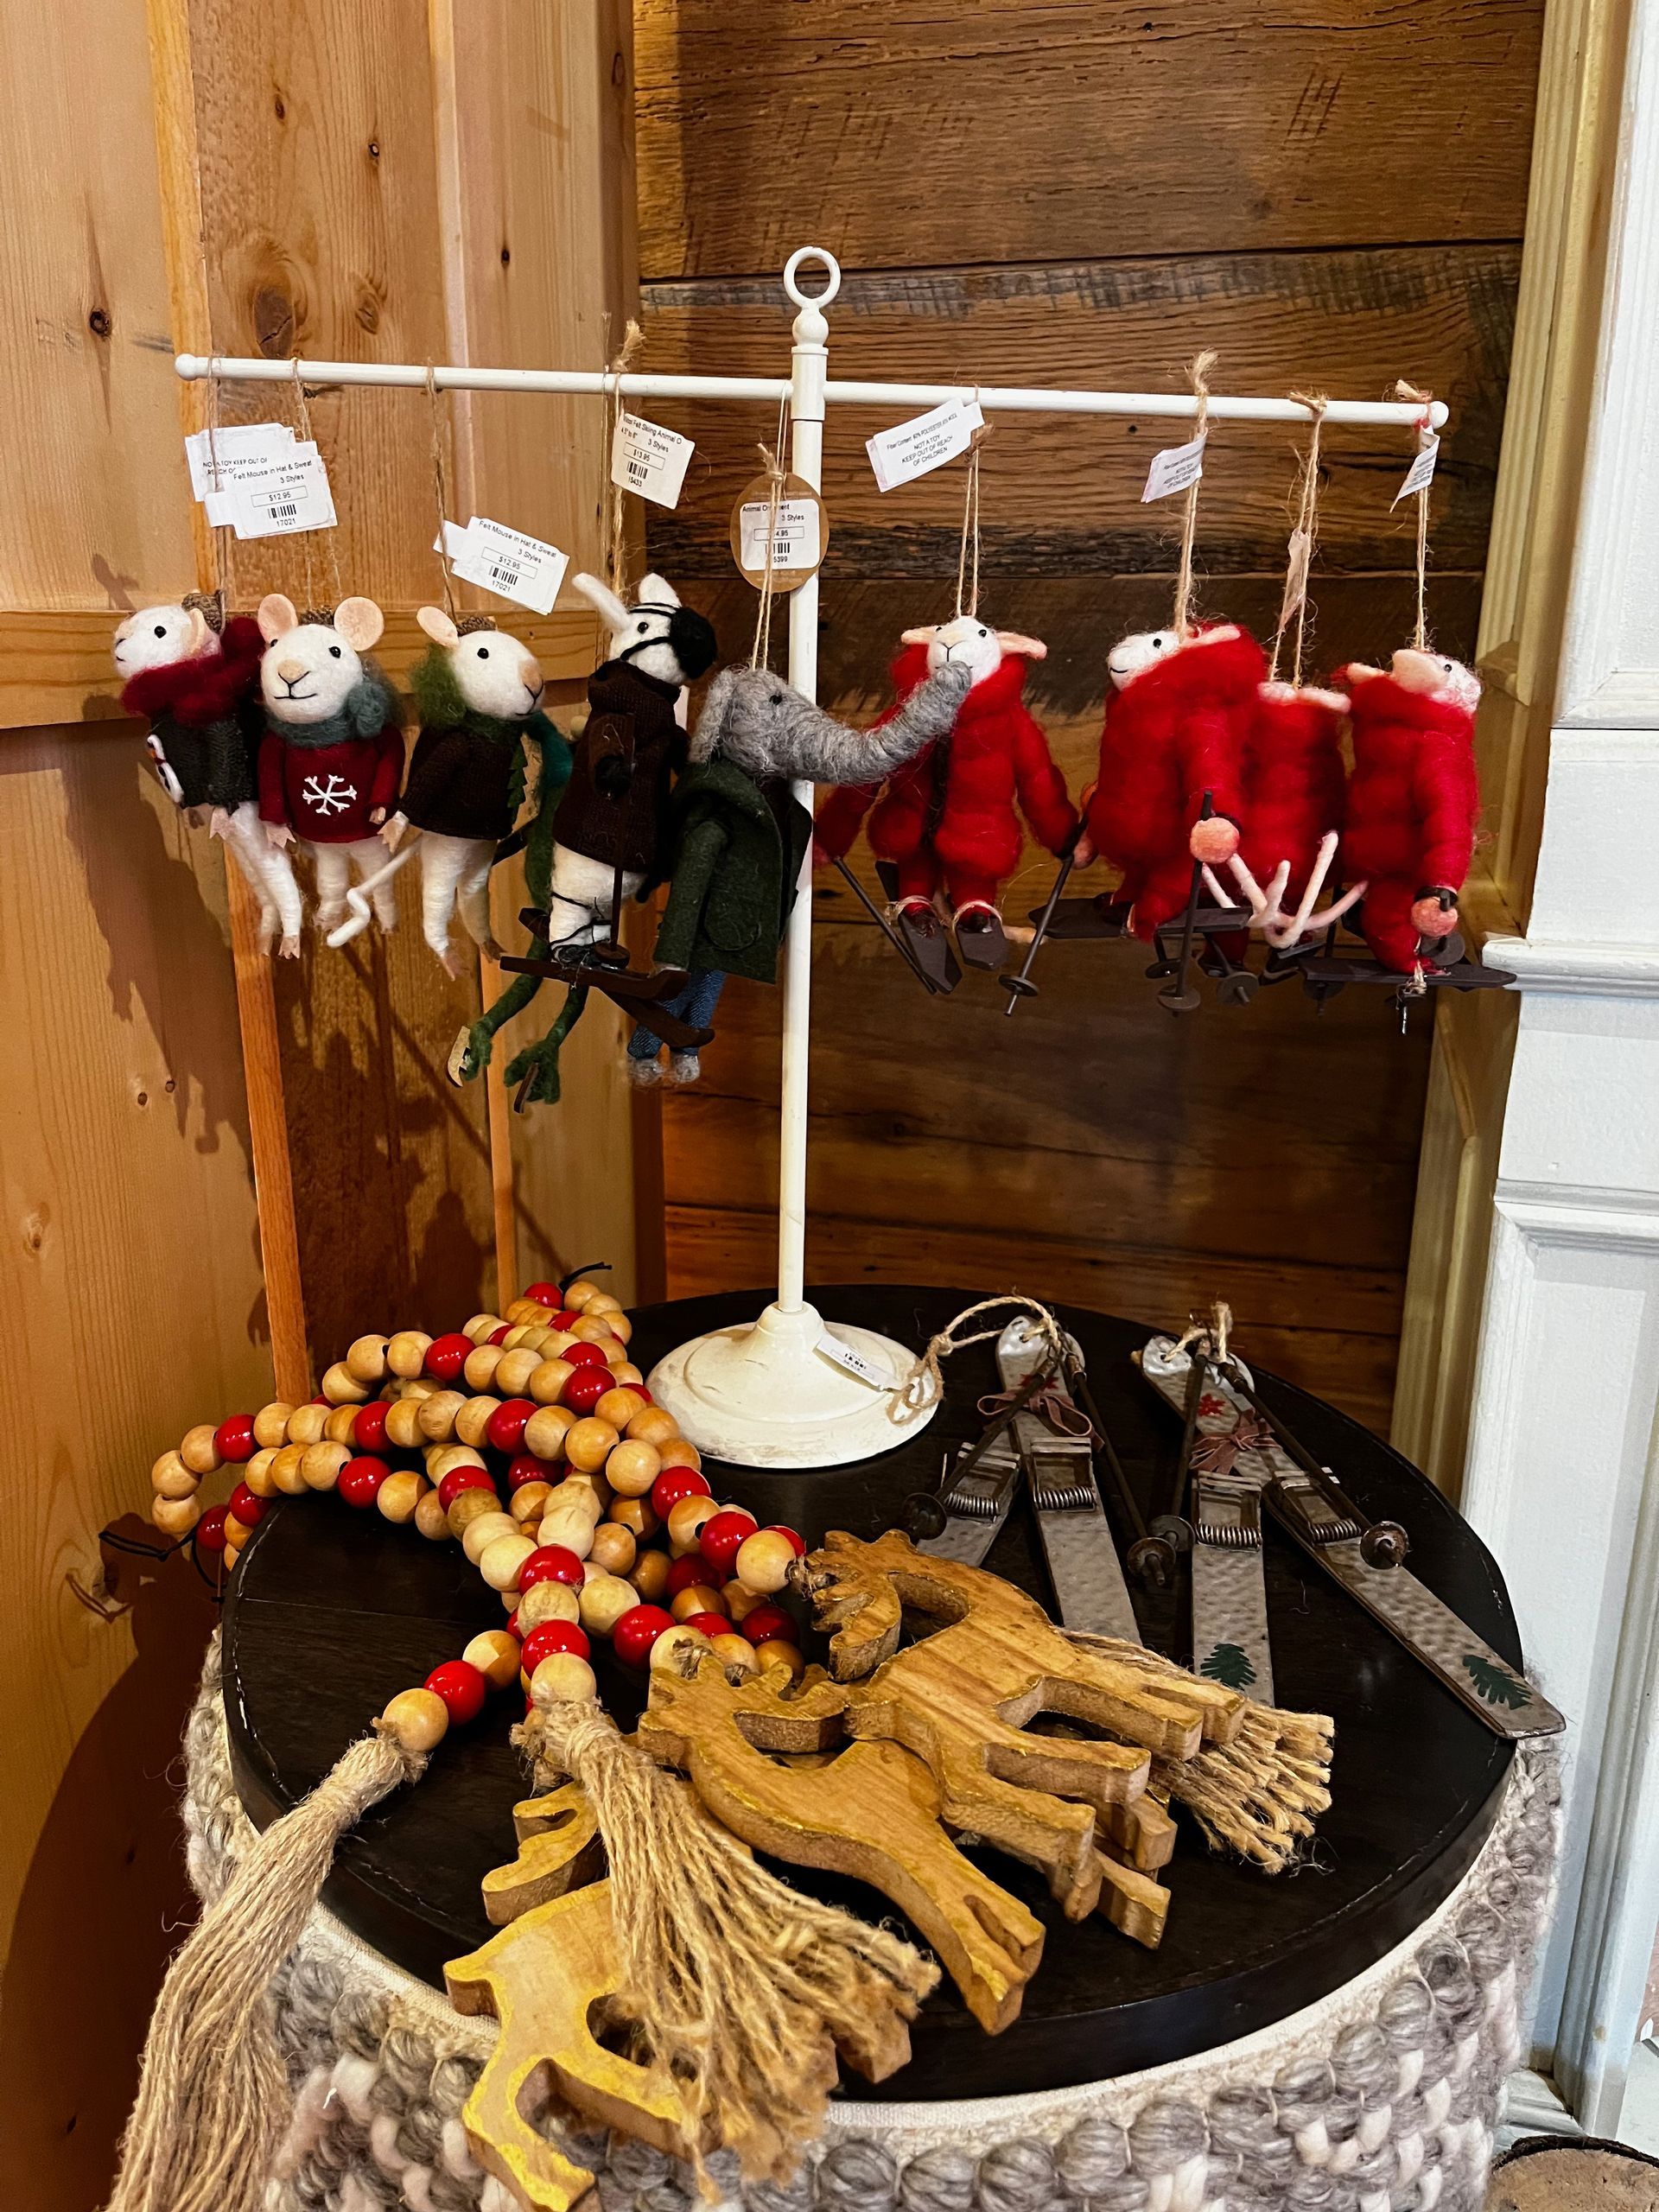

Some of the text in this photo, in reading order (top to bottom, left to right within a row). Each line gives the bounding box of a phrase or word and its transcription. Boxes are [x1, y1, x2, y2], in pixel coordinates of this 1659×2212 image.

[658, 430, 676, 442] Animal
[914, 440, 925, 450] NOT
[930, 434, 940, 443] TOY
[653, 441, 669, 453] Styles
[902, 453, 916, 463] KEEP
[917, 447, 928, 457] OUT
[937, 435, 953, 447] REACH
[921, 447, 948, 462] CHILDREN
[247, 469, 268, 478] Mouse
[294, 460, 312, 469] Sweat
[286, 474, 304, 484] Styles
[269, 492, 291, 501] $12.95
[276, 518, 296, 527] 17021
[479, 520, 491, 530] Felt
[492, 526, 512, 539] Mouse
[520, 537, 530, 546] Hat
[538, 545, 557, 558] Sweat
[499, 556, 520, 570] $12.95
[524, 551, 541, 564] Styles
[492, 580, 510, 592] 17021
